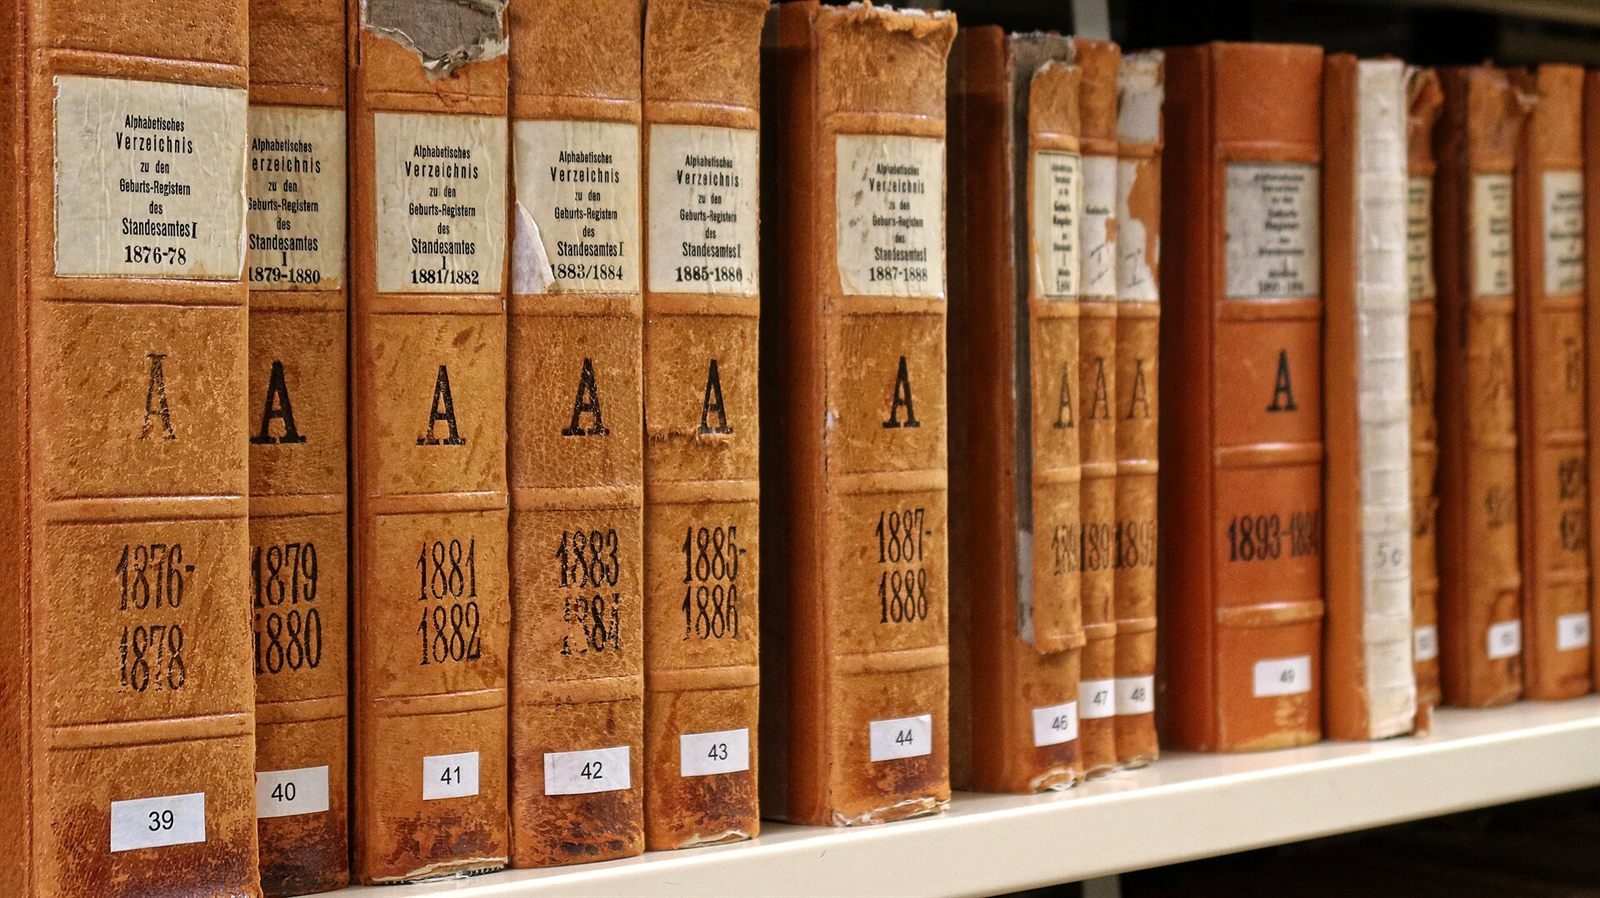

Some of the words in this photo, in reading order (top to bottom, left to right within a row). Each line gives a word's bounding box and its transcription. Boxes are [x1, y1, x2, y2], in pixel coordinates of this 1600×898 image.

[125, 114, 184, 131] Alphabetisches
[116, 132, 193, 154] Verzeichnis
[252, 138, 312, 152] Alphabetisches
[413, 144, 470, 160] Alphabetisches
[559, 150, 612, 165] Alphabetisches
[140, 161, 149, 173] zu
[156, 160, 170, 173] den
[252, 157, 320, 173] erzeichnis
[685, 154, 733, 168] Alphabetisches
[405, 162, 478, 179] Verzeichnis
[551, 167, 620, 183] Verzeichnis
[677, 170, 739, 186] Verzeichnis
[120, 179, 190, 196] Geburts-Registern
[268, 182, 276, 192] zu
[284, 180, 297, 192] den
[430, 186, 438, 198] zu
[444, 184, 456, 198] den
[869, 178, 924, 194] Verzeichnis
[575, 191, 582, 202] zu
[588, 189, 601, 202] den
[698, 194, 706, 204] zu
[711, 193, 721, 204] den
[149, 201, 163, 214] des
[409, 203, 475, 218] Geburts-Registern
[900, 199, 910, 211] den
[554, 207, 618, 221] Geburts-Registern
[680, 209, 737, 223] Geburts-Registern
[122, 219, 190, 237] Standesamtes
[277, 218, 290, 230] des
[437, 222, 449, 234] des
[583, 225, 595, 237] des
[705, 227, 716, 238] des
[250, 234, 318, 251] Standesamtes
[412, 238, 475, 255] Standesamtes
[895, 234, 905, 244] des
[124, 246, 186, 264] 1876-78
[557, 240, 618, 257] Standesamtes
[682, 241, 736, 258] Standesamtes
[282, 252, 287, 266] I
[249, 268, 320, 283] 1879-1880
[411, 269, 479, 284] 1881/1882
[550, 264, 623, 281] 1883/1884
[675, 266, 743, 282] 1885-1886
[869, 267, 927, 282] 1887-1888
[1089, 357, 1110, 420] A
[1126, 358, 1150, 419] A
[1266, 350, 1297, 412] A
[138, 353, 178, 440] A
[562, 357, 610, 436] A
[696, 359, 734, 434] A
[882, 356, 920, 428] A
[1053, 361, 1074, 429] A
[250, 360, 307, 444] A
[416, 365, 466, 446] A
[1080, 521, 1110, 573] 189
[555, 528, 619, 589] 1883
[251, 543, 318, 609] 1879
[416, 538, 477, 600] 1881
[878, 568, 928, 624] 1888
[682, 583, 739, 641] 1886
[416, 602, 481, 665] 1882
[119, 624, 185, 693] 1878
[1279, 669, 1296, 685] 49
[1093, 690, 1108, 707] 47
[1130, 687, 1146, 702] 48
[1051, 715, 1069, 732] 46
[895, 729, 913, 747] 44
[707, 743, 728, 761] 43
[440, 766, 462, 786] 41
[580, 761, 603, 781] 42
[271, 781, 296, 803] 40
[148, 810, 175, 832] 39
